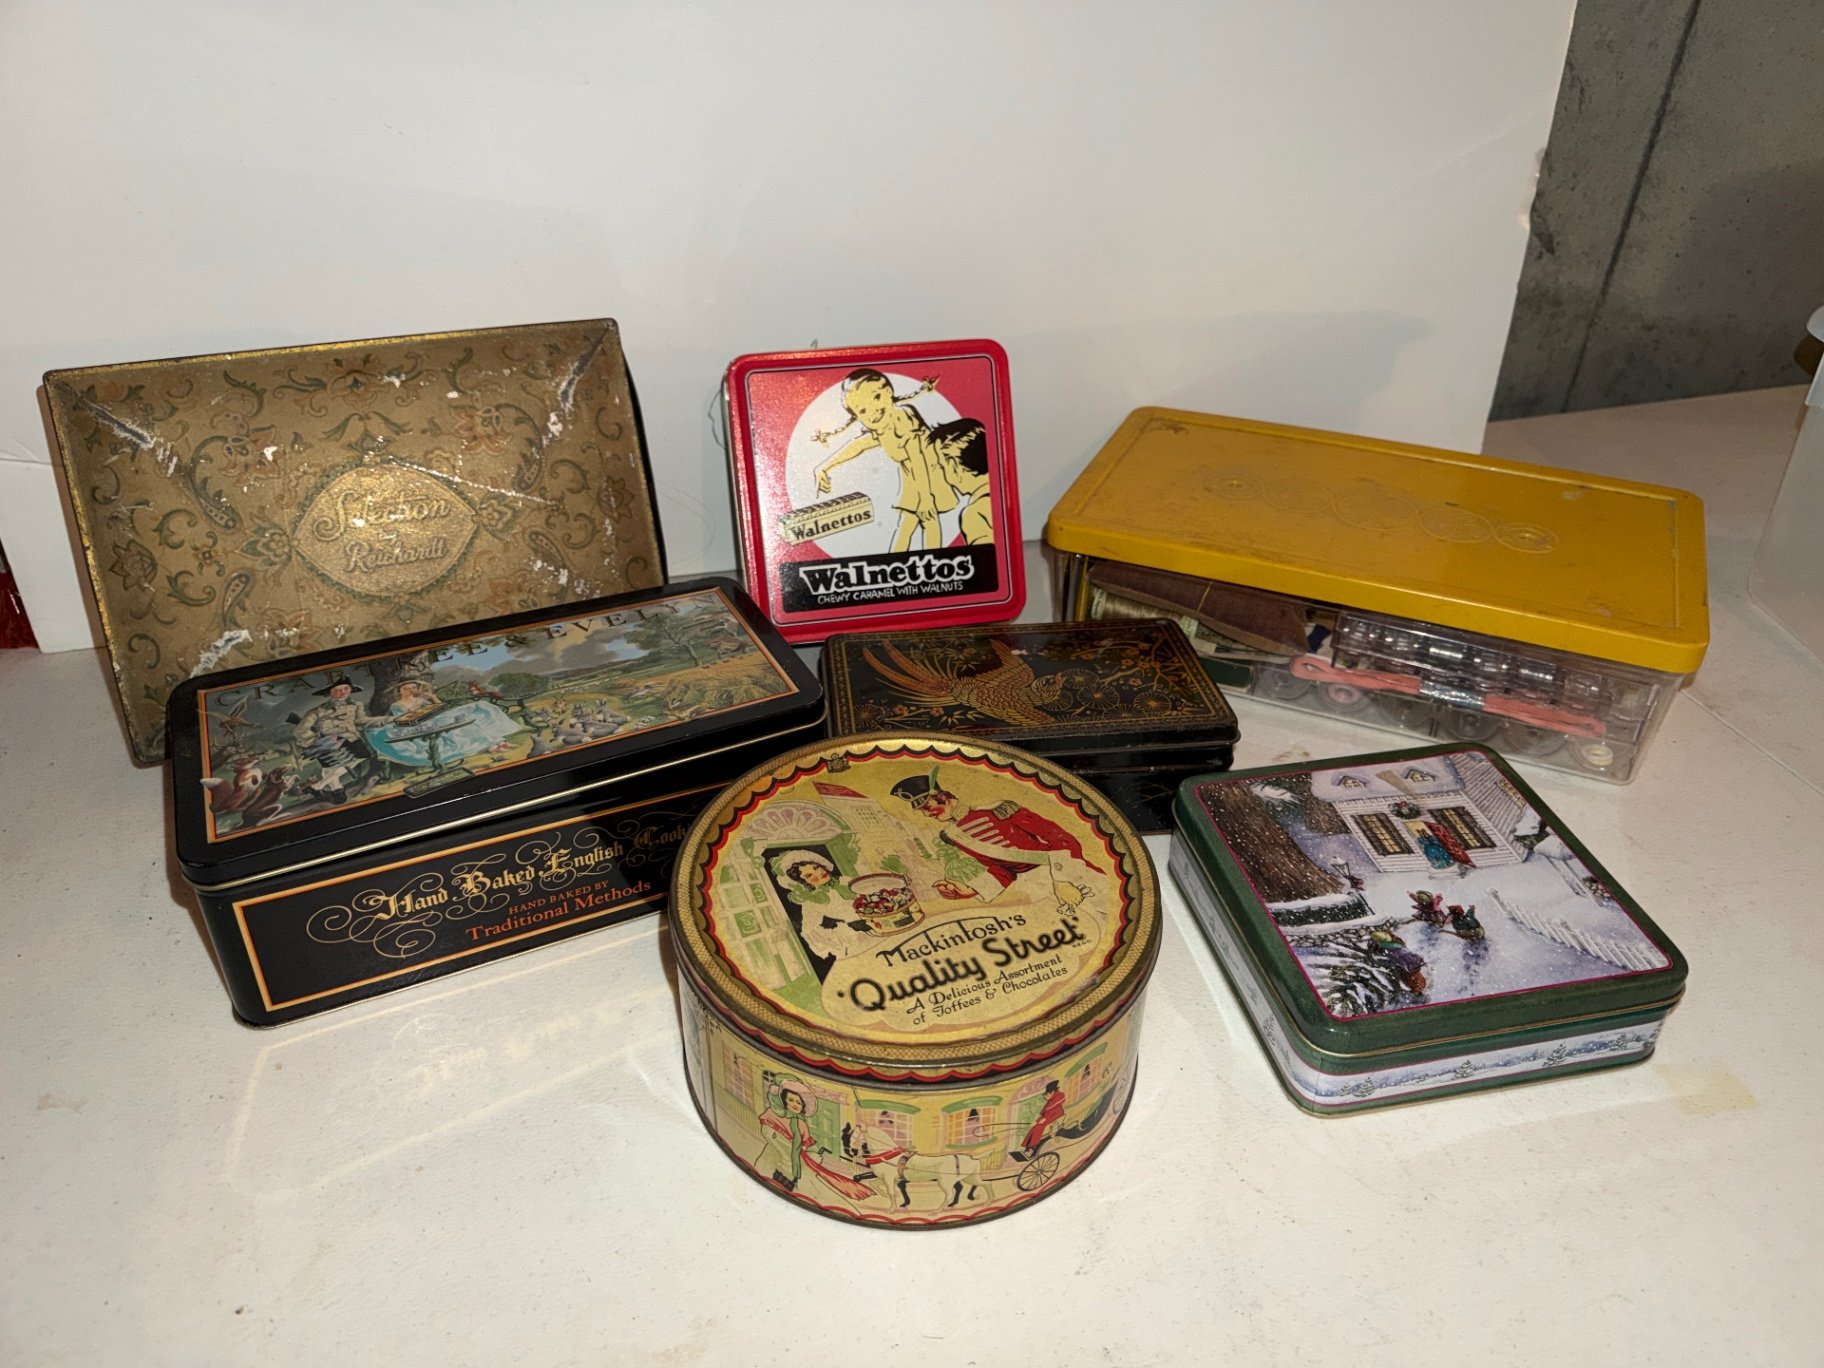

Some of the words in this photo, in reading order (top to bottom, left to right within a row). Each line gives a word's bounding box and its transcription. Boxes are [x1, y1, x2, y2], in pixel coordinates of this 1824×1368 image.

[792, 510, 872, 540] Walnettos
[346, 536, 448, 573] Reichardt
[799, 554, 975, 595] Walnettos
[817, 593, 850, 605] CHEWY
[853, 588, 895, 601] CARAMEL
[896, 584, 918, 595] WITH
[920, 581, 963, 593] WALNUTS
[504, 633, 528, 648] &
[545, 594, 716, 639] EVELYN
[366, 886, 449, 921] Hand
[453, 865, 537, 899] Baked
[539, 841, 624, 878] English
[634, 823, 689, 850] Cook
[509, 898, 546, 915] HAND
[551, 884, 591, 902] BAKED
[595, 879, 609, 891] BY
[466, 901, 569, 942] Traditional
[574, 880, 651, 911] Methods
[849, 956, 988, 1011] Quality
[981, 917, 1086, 968] Street
[875, 914, 1027, 967] Mackintosh's
[906, 997, 926, 1015] A
[928, 979, 992, 1005] Delicious
[993, 953, 1063, 985] Assortment
[913, 1011, 926, 1025] of
[931, 995, 981, 1017] Toffees
[984, 988, 997, 999] &
[1001, 966, 1068, 994] Chocolates
